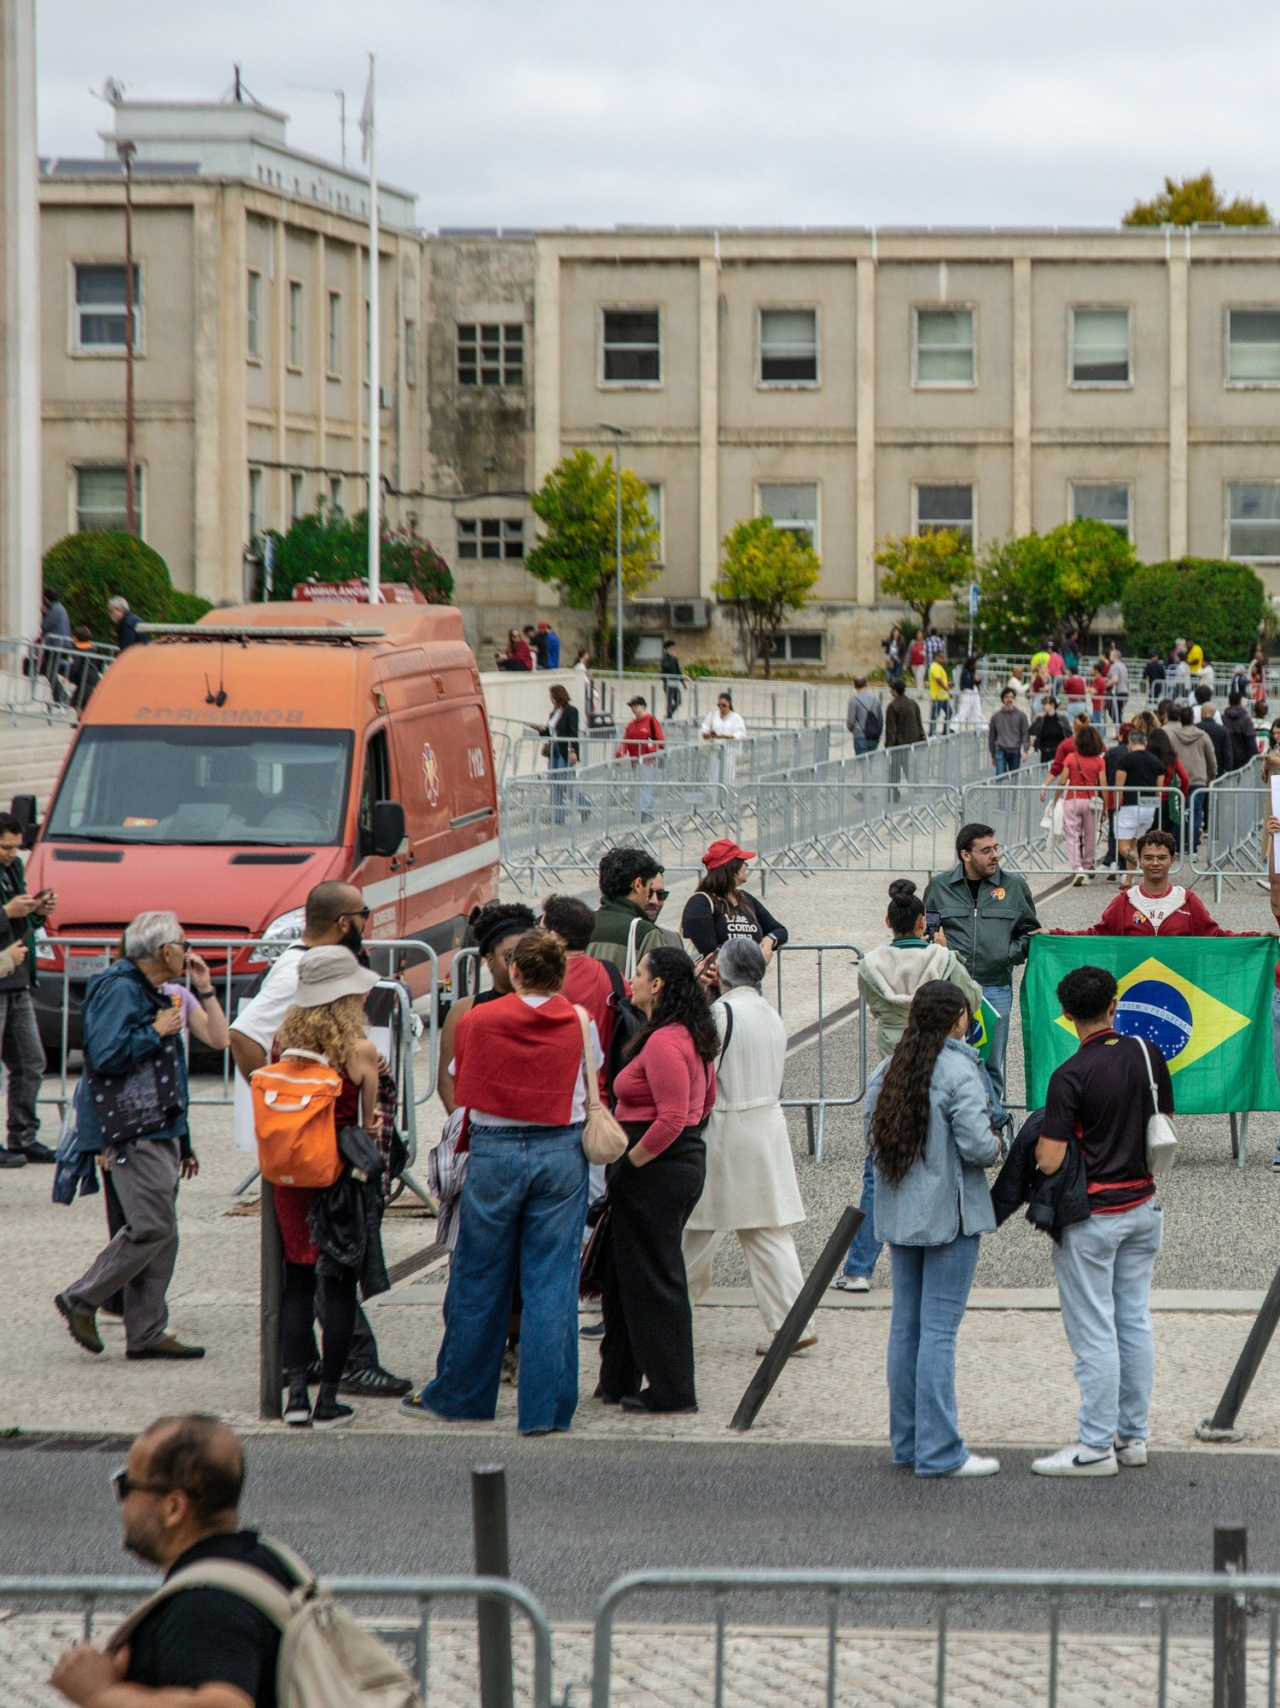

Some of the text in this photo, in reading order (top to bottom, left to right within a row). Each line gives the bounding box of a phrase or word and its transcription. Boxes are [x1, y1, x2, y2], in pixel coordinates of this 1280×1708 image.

[727, 923, 758, 933] como
[1117, 1002, 1141, 1010] ORDEM
[1150, 1008, 1192, 1033] PROGRESSO
